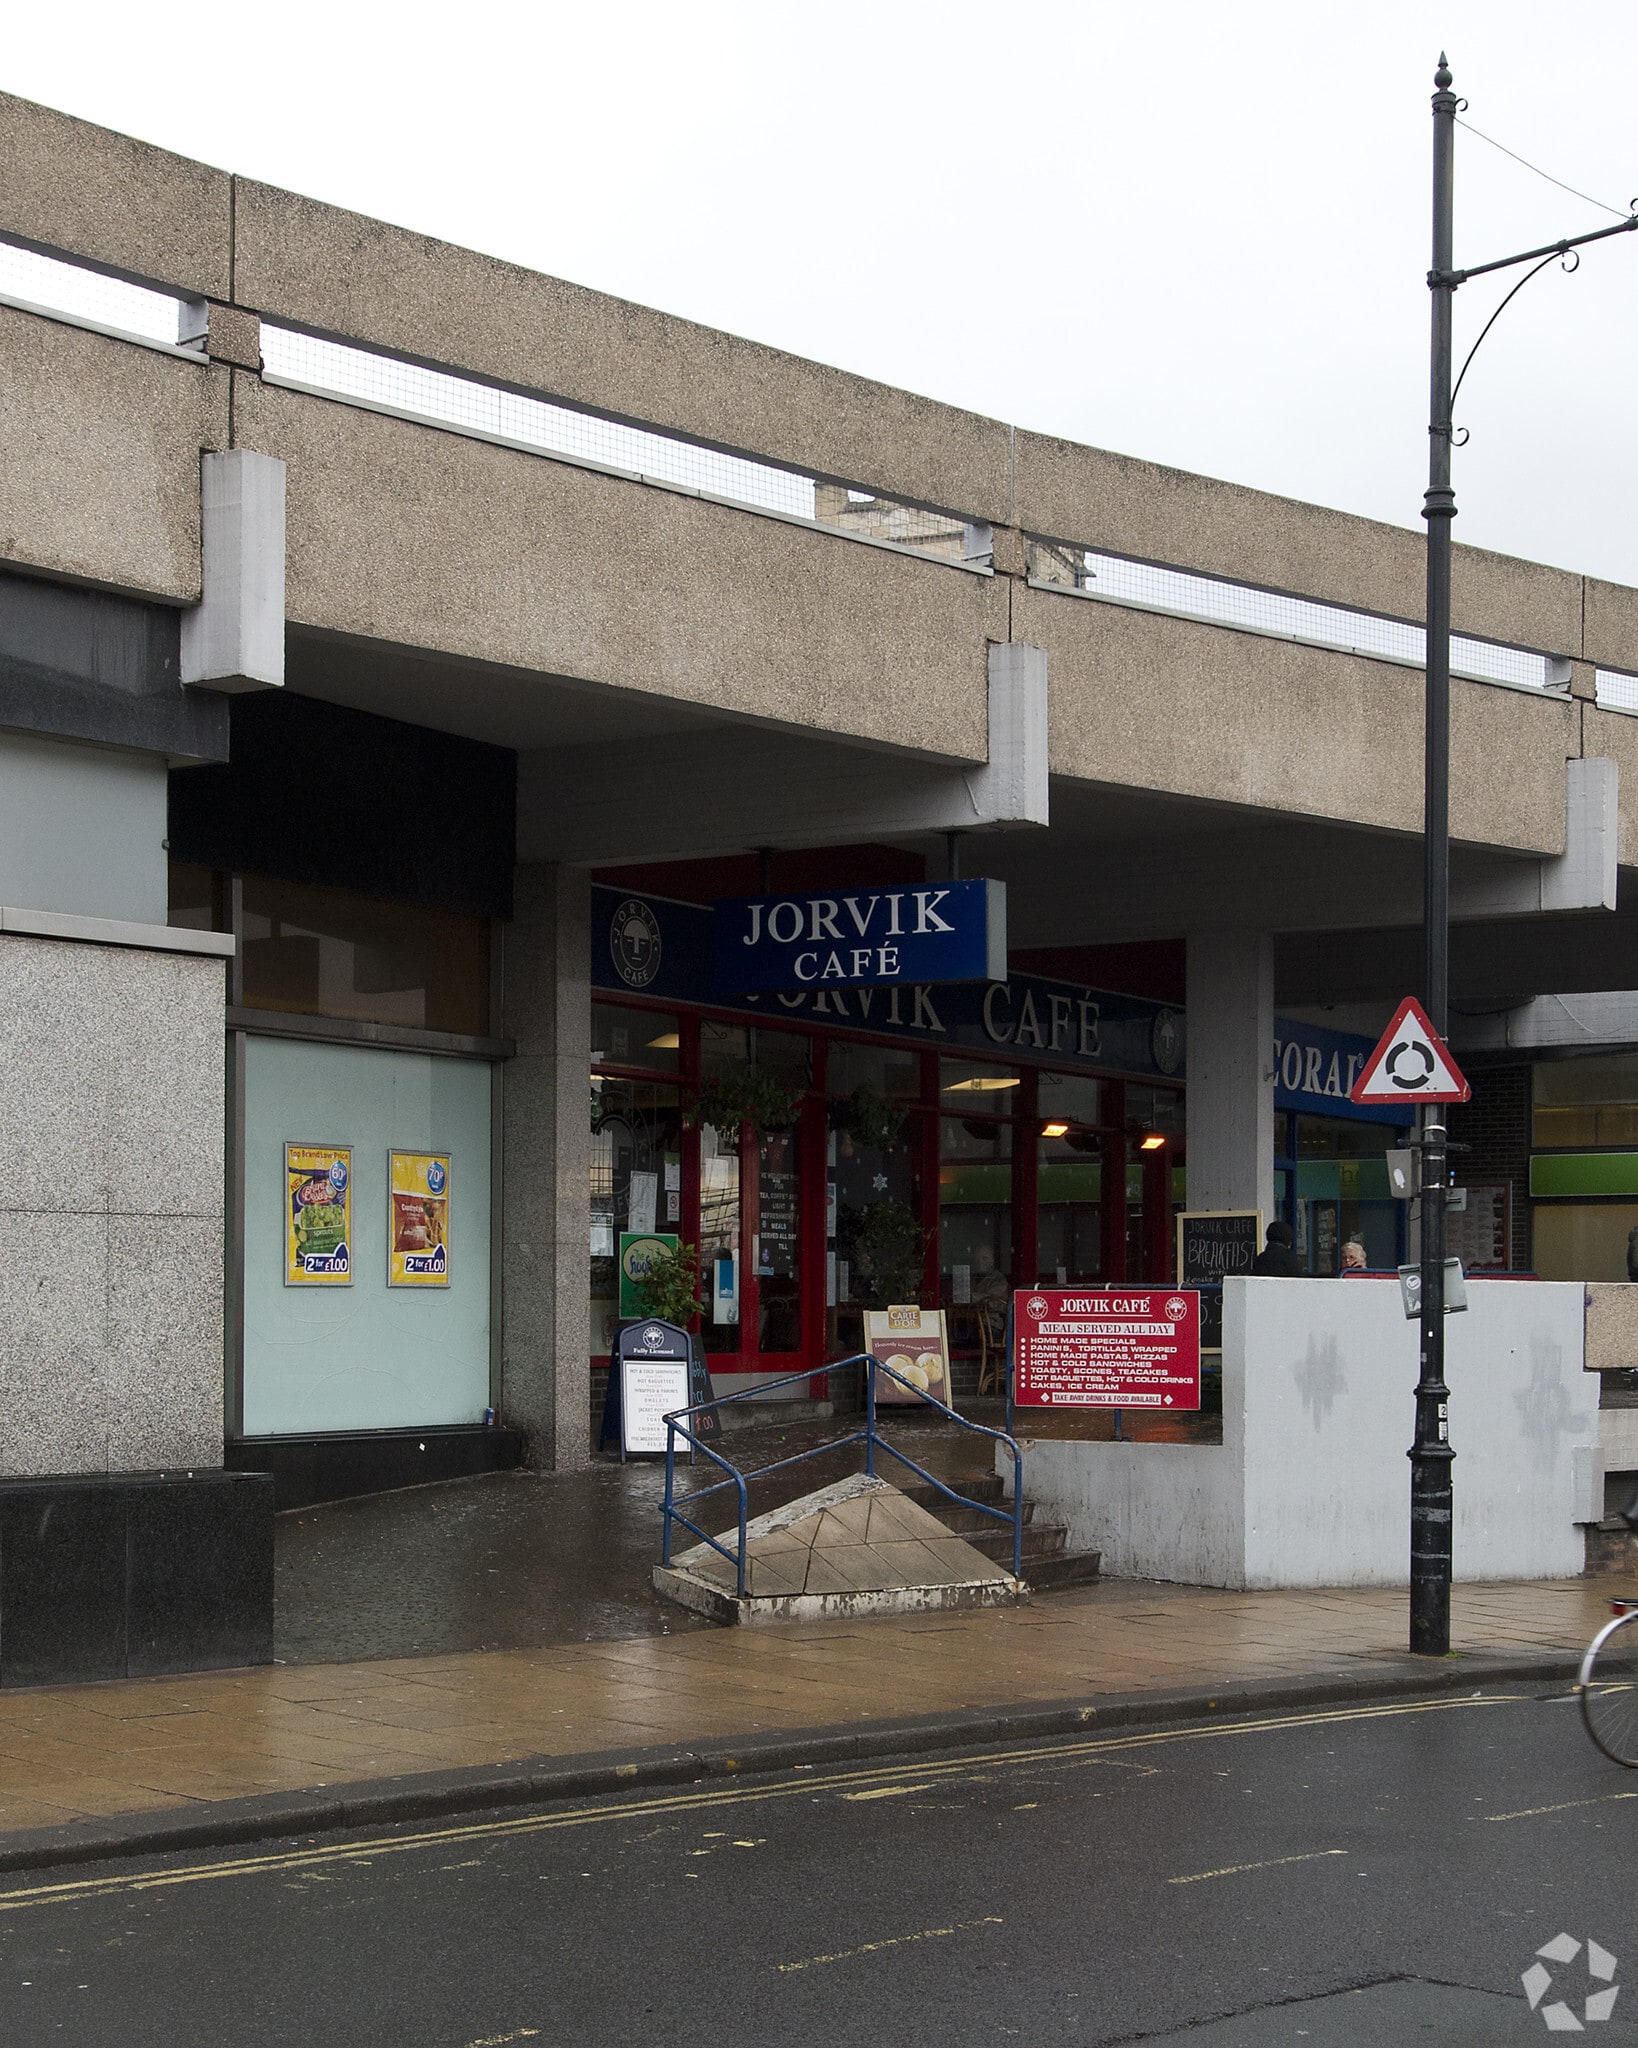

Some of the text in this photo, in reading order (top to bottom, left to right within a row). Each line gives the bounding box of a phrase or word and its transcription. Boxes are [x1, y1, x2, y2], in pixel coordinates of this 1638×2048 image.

[614, 903, 659, 943] JORVIK
[743, 890, 955, 946] JORVIK
[794, 941, 901, 981] CAFÉ
[984, 984, 1101, 1056] CAFÉ
[290, 1149, 300, 1157] Top
[1188, 1239, 1256, 1270] BREAKFAST
[307, 1258, 348, 1271] 2 for £1.00
[407, 1258, 444, 1271] 2 for £1.00
[1060, 1299, 1110, 1312] JORVIK
[1112, 1296, 1151, 1312] CAFÉ
[890, 1311, 918, 1321] CARTE
[894, 1320, 916, 1328] D'OR
[1042, 1324, 1171, 1334] MEAL SERVED ALL DAY
[1090, 1353, 1131, 1361] PASTAS,
[1089, 1360, 1152, 1368] SANDWICHES
[1030, 1367, 1070, 1375] TOASTY,
[1118, 1368, 1168, 1376] TEACAKES
[1050, 1375, 1104, 1383] BAGUETTES,
